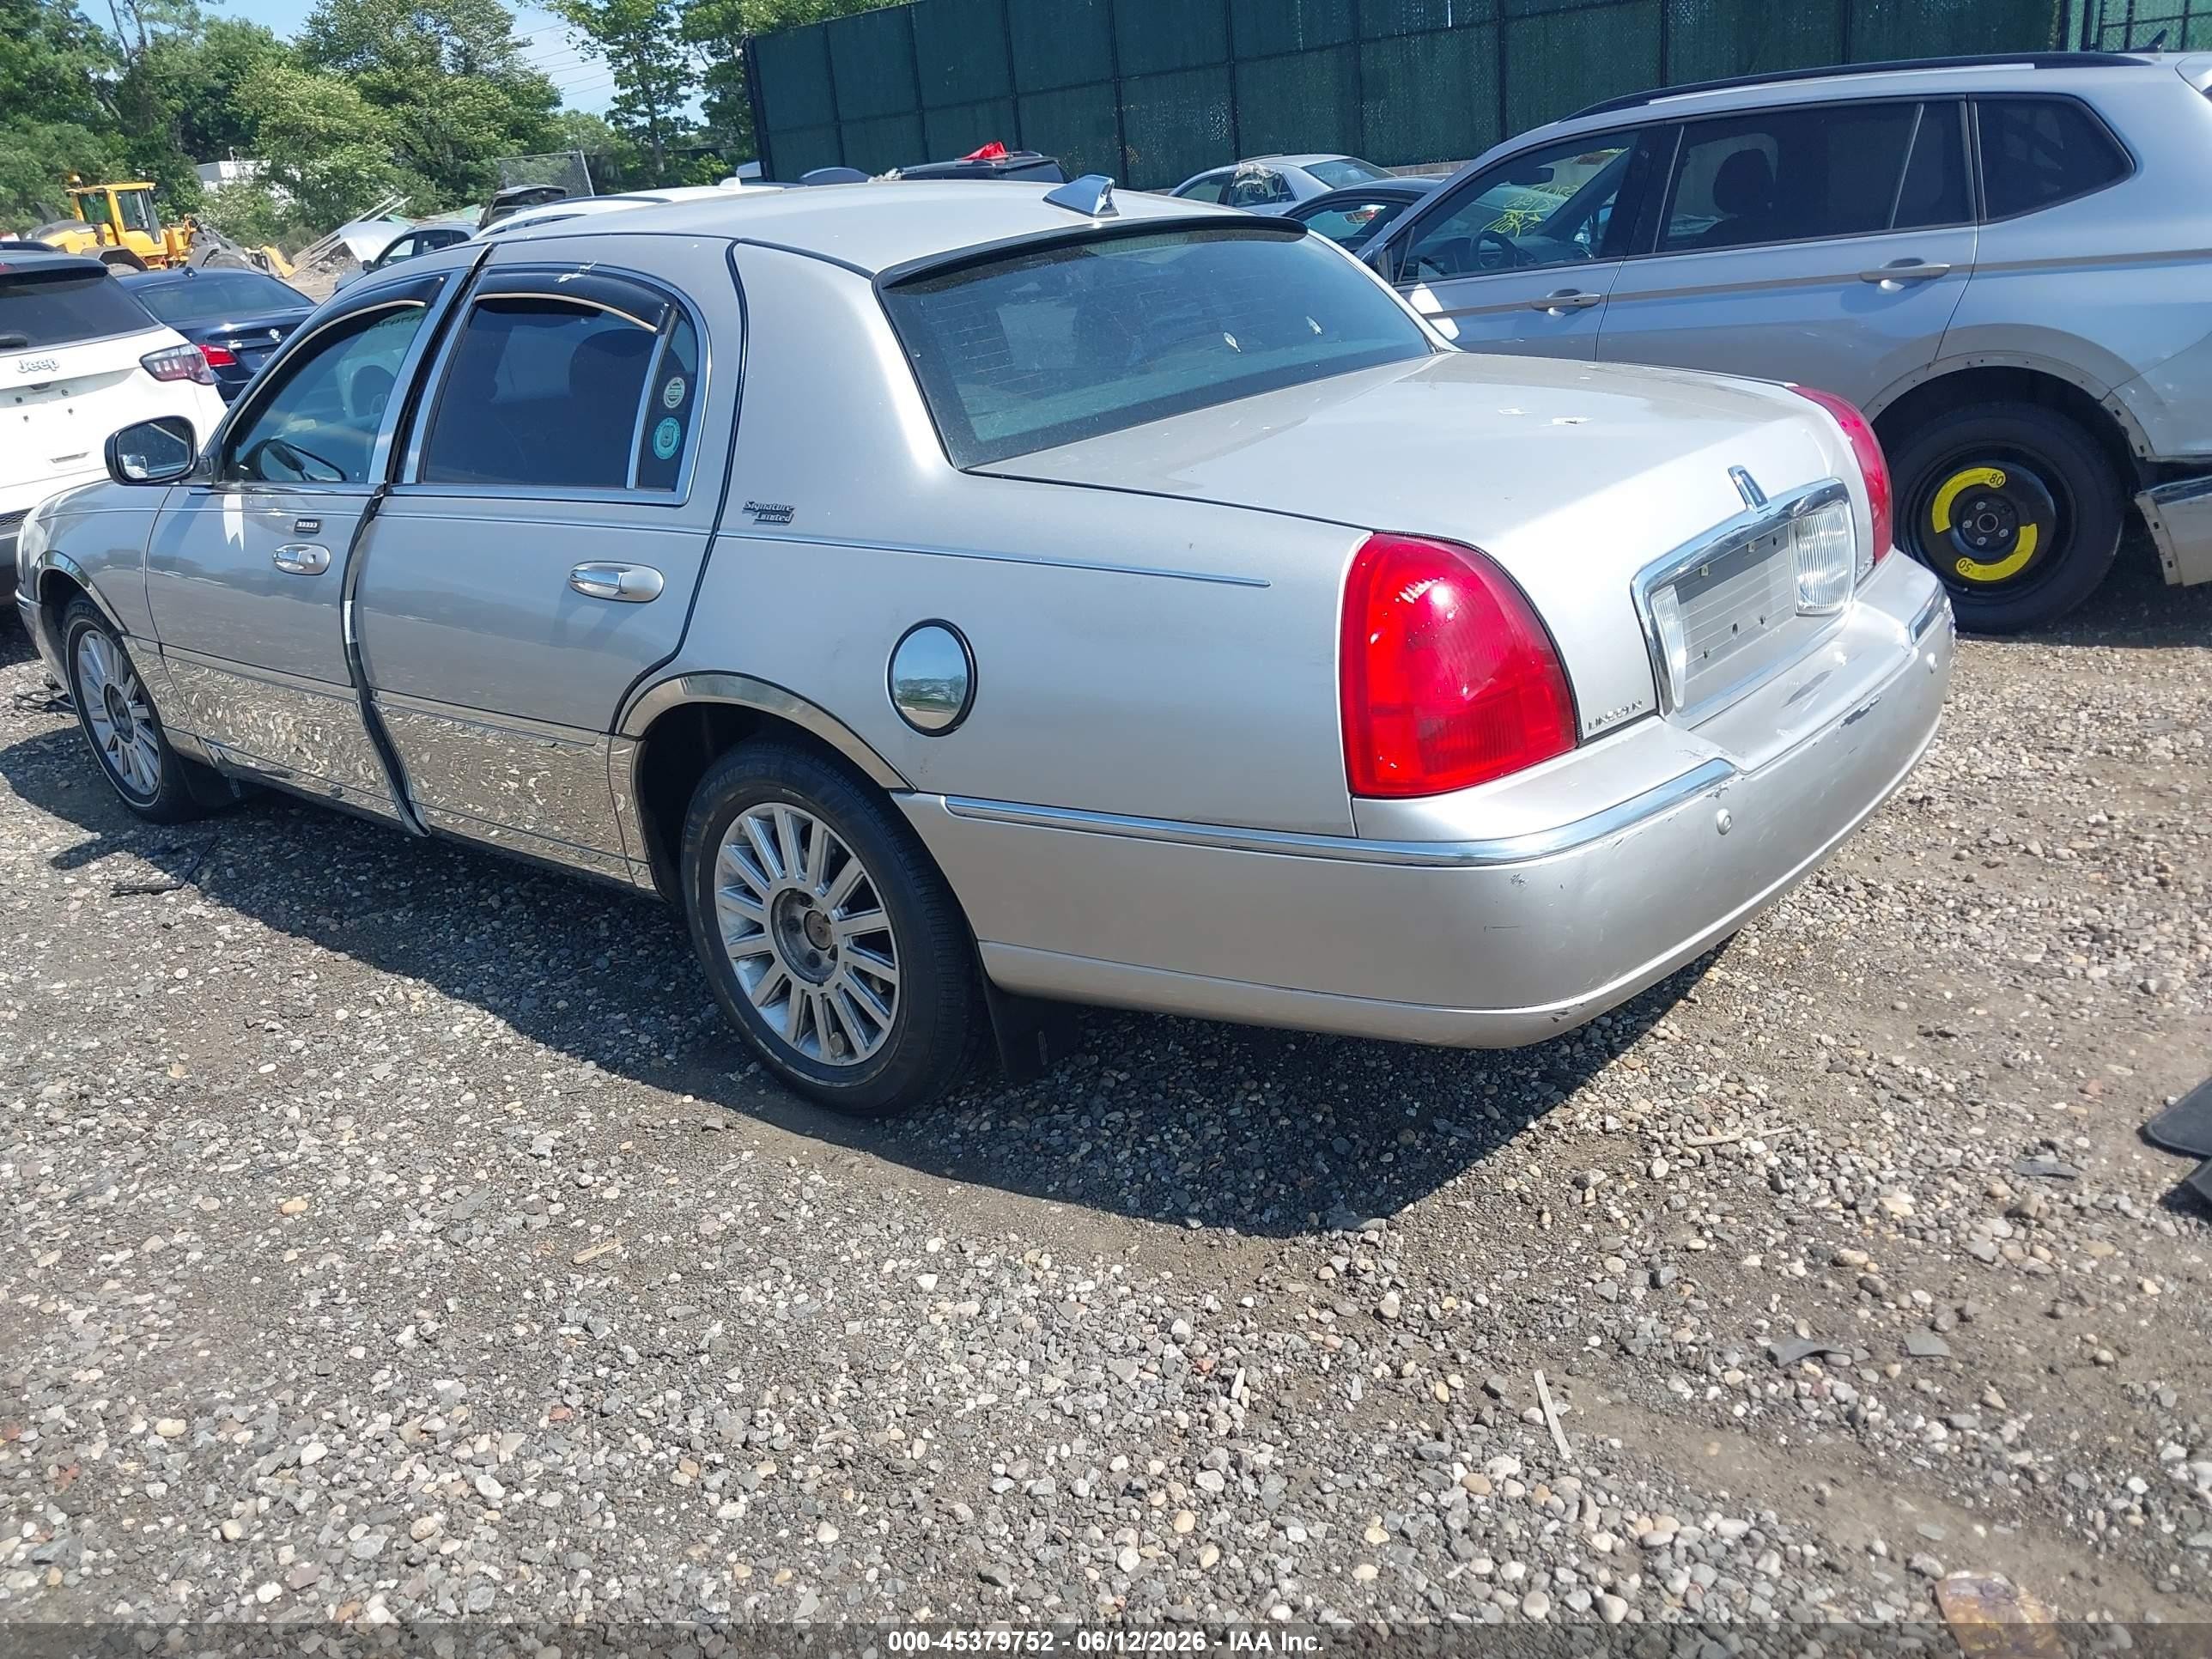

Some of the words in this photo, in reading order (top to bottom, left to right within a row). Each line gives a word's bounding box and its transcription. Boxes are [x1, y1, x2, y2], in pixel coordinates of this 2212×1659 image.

[17, 358, 60, 373] Jeep
[1989, 473, 2004, 486] 80
[743, 501, 795, 512] Signature
[1958, 559, 1973, 573] 50
